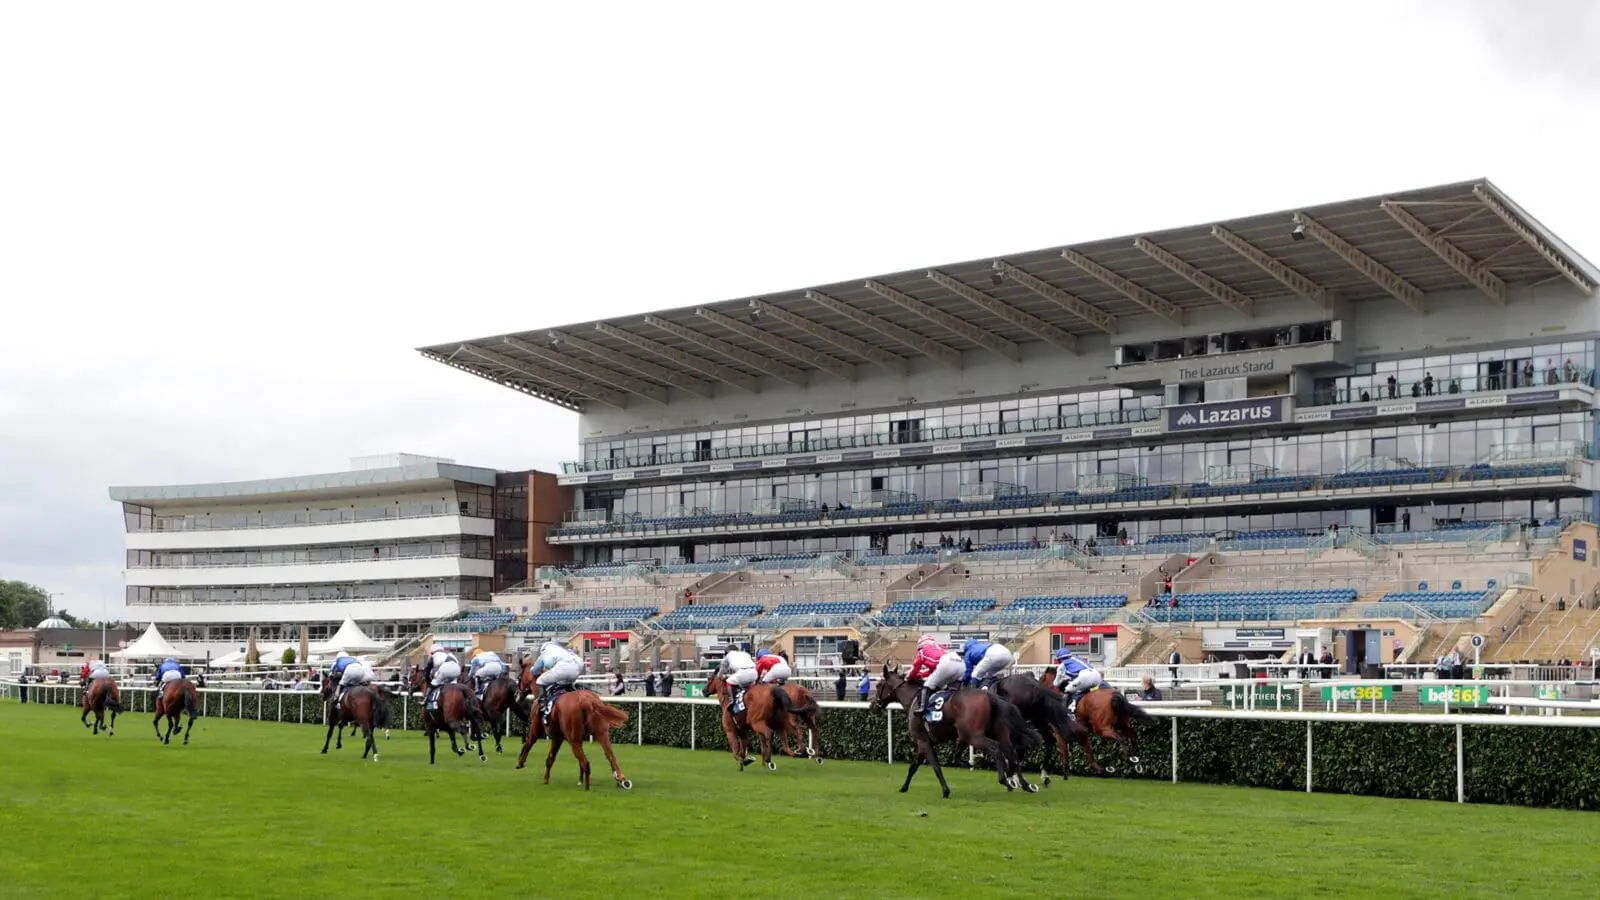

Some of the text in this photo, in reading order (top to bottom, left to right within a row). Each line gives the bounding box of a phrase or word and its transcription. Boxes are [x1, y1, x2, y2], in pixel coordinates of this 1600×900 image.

[1179, 360, 1274, 380] The Lazarus Stand
[1199, 405, 1272, 424] Lazarus
[1331, 686, 1383, 700] bet365
[934, 696, 945, 710] 3
[1068, 699, 1077, 713] 4
